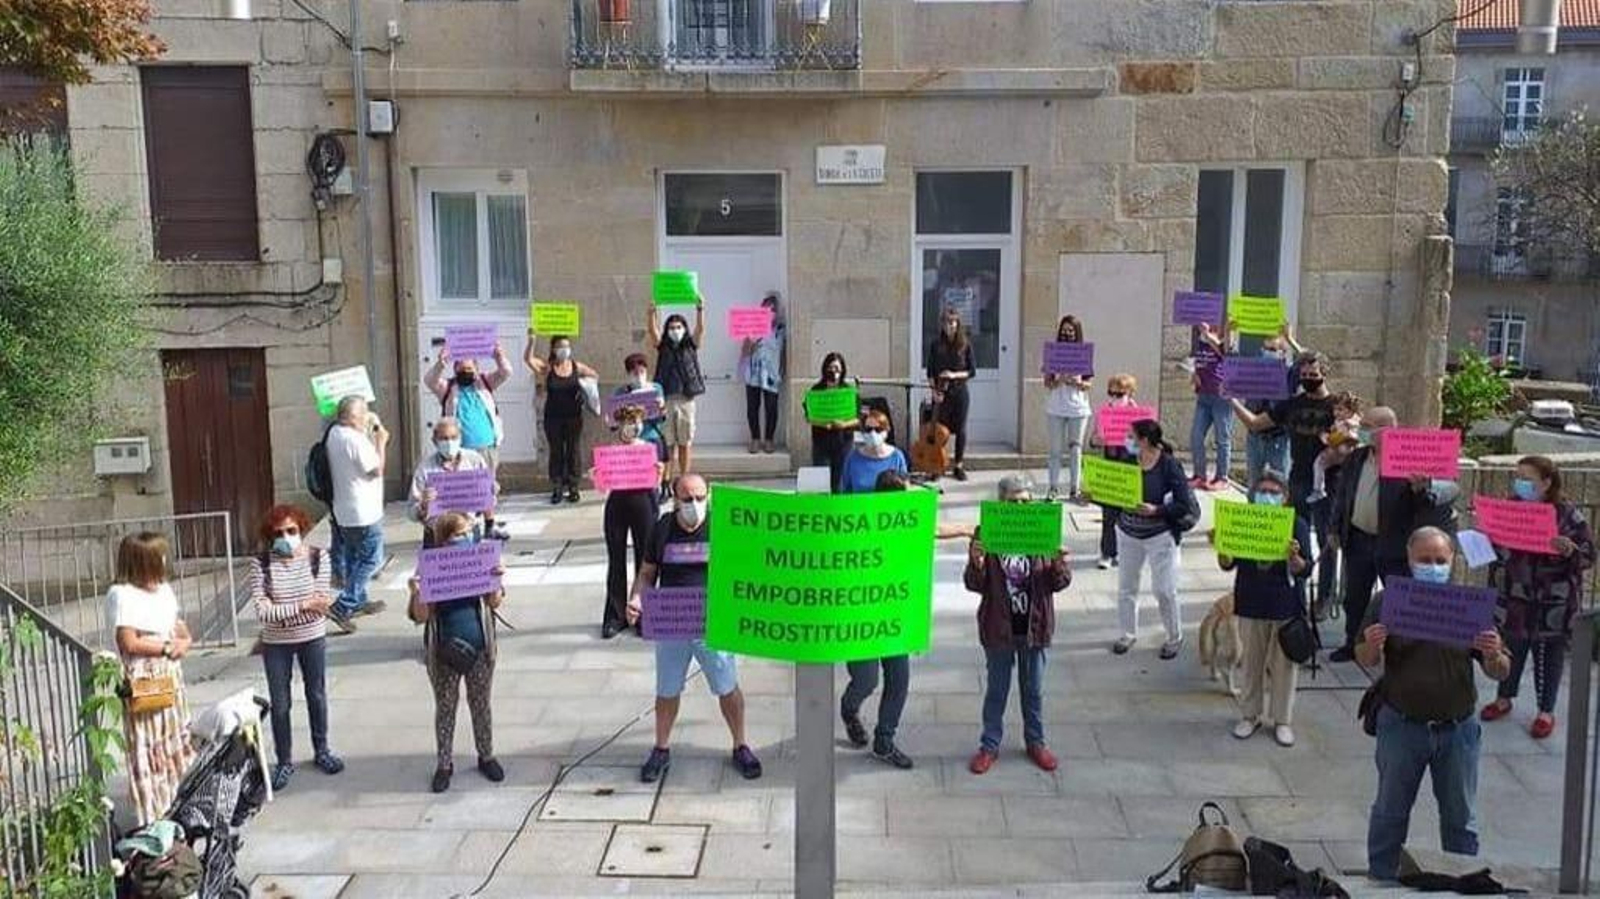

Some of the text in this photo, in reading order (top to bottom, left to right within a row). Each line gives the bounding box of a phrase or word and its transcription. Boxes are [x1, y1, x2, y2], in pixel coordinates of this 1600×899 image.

[721, 199, 730, 215] 5
[730, 507, 918, 534] EN DEFENSA DAS
[765, 548, 884, 570] MULLERES
[732, 580, 910, 607] EMPOBRECIDAS
[738, 617, 902, 643] PROSTITUIDAS
